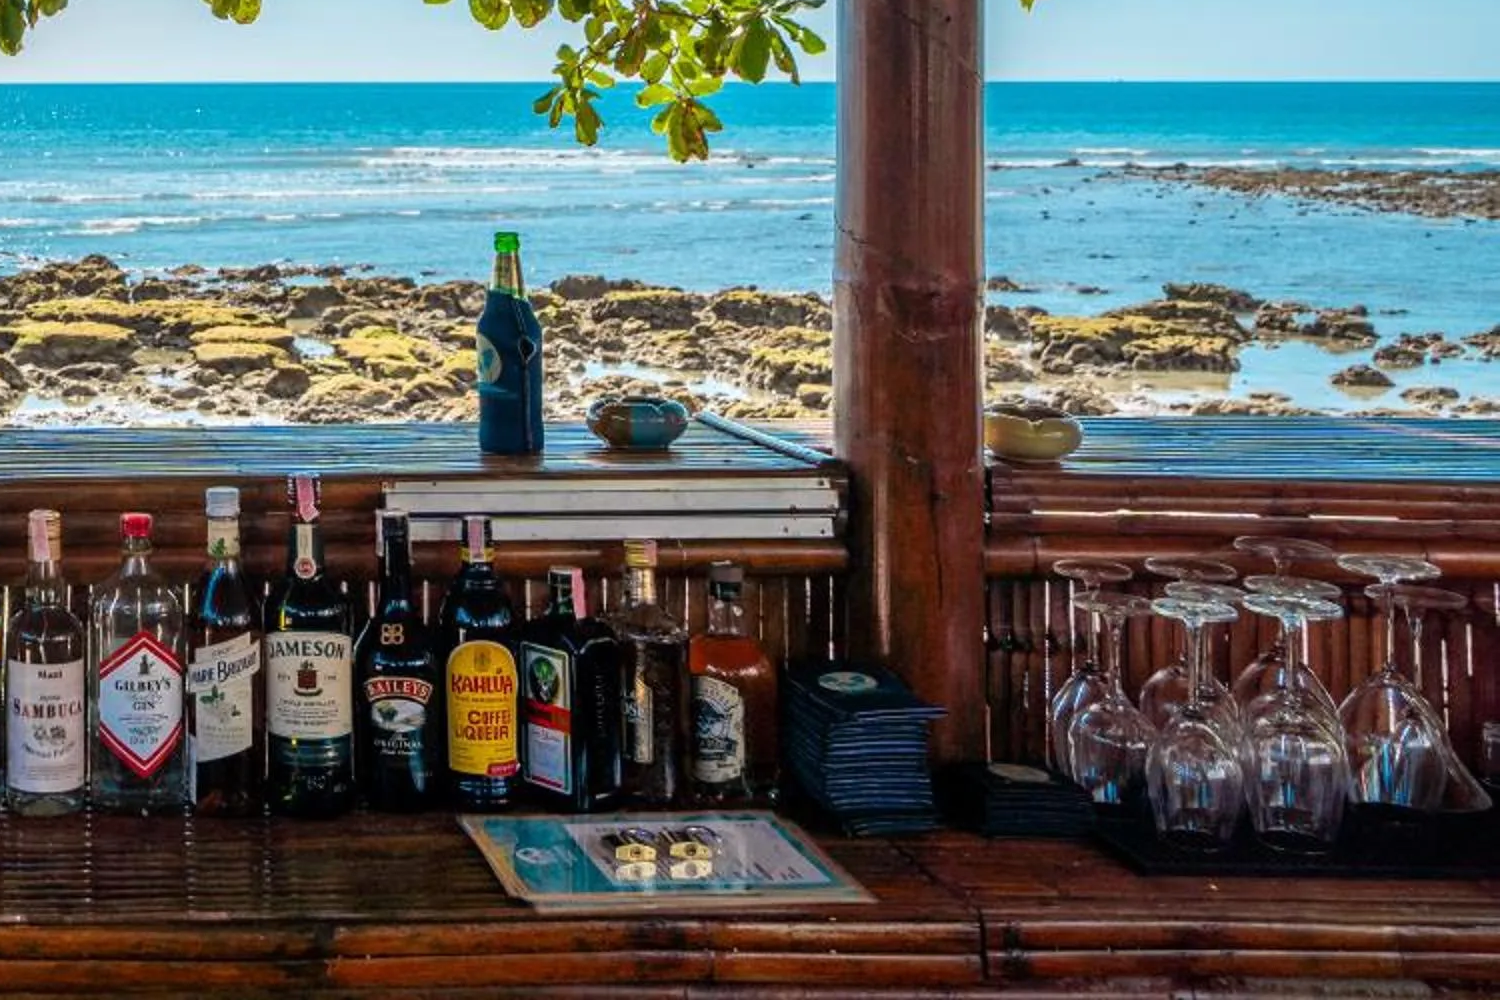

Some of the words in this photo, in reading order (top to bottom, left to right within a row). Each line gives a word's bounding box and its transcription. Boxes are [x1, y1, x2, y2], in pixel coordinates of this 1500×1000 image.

[268, 640, 346, 660] JAMESON
[368, 680, 430, 698] BAILEYS
[12, 697, 83, 719] SAMBUCA
